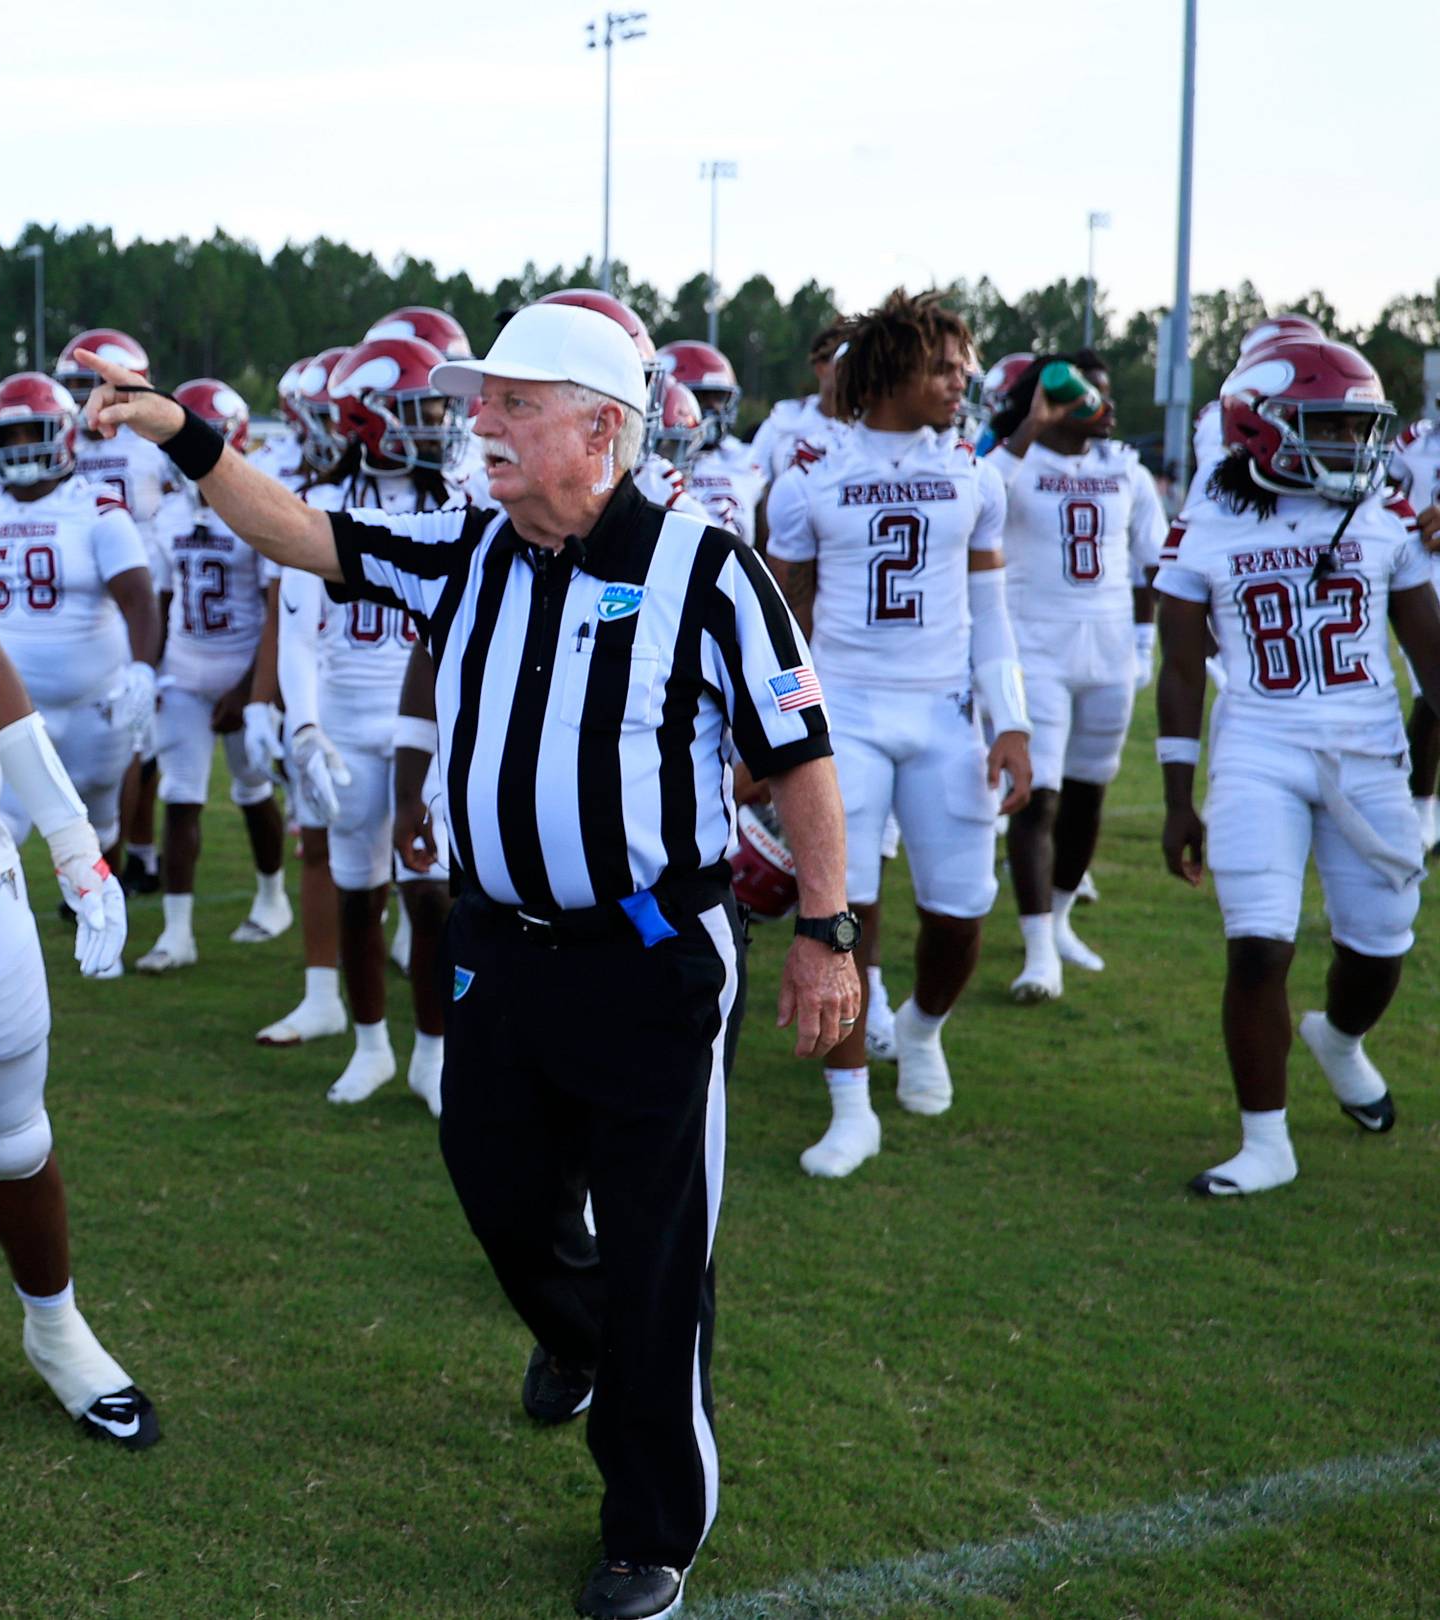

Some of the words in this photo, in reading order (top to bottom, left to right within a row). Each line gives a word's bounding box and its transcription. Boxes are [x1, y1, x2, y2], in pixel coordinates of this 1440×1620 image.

[838, 480, 958, 507] RAINES
[867, 507, 929, 627] 2
[1060, 496, 1104, 588] 8
[176, 554, 235, 638] 12
[1234, 569, 1380, 698] 82
